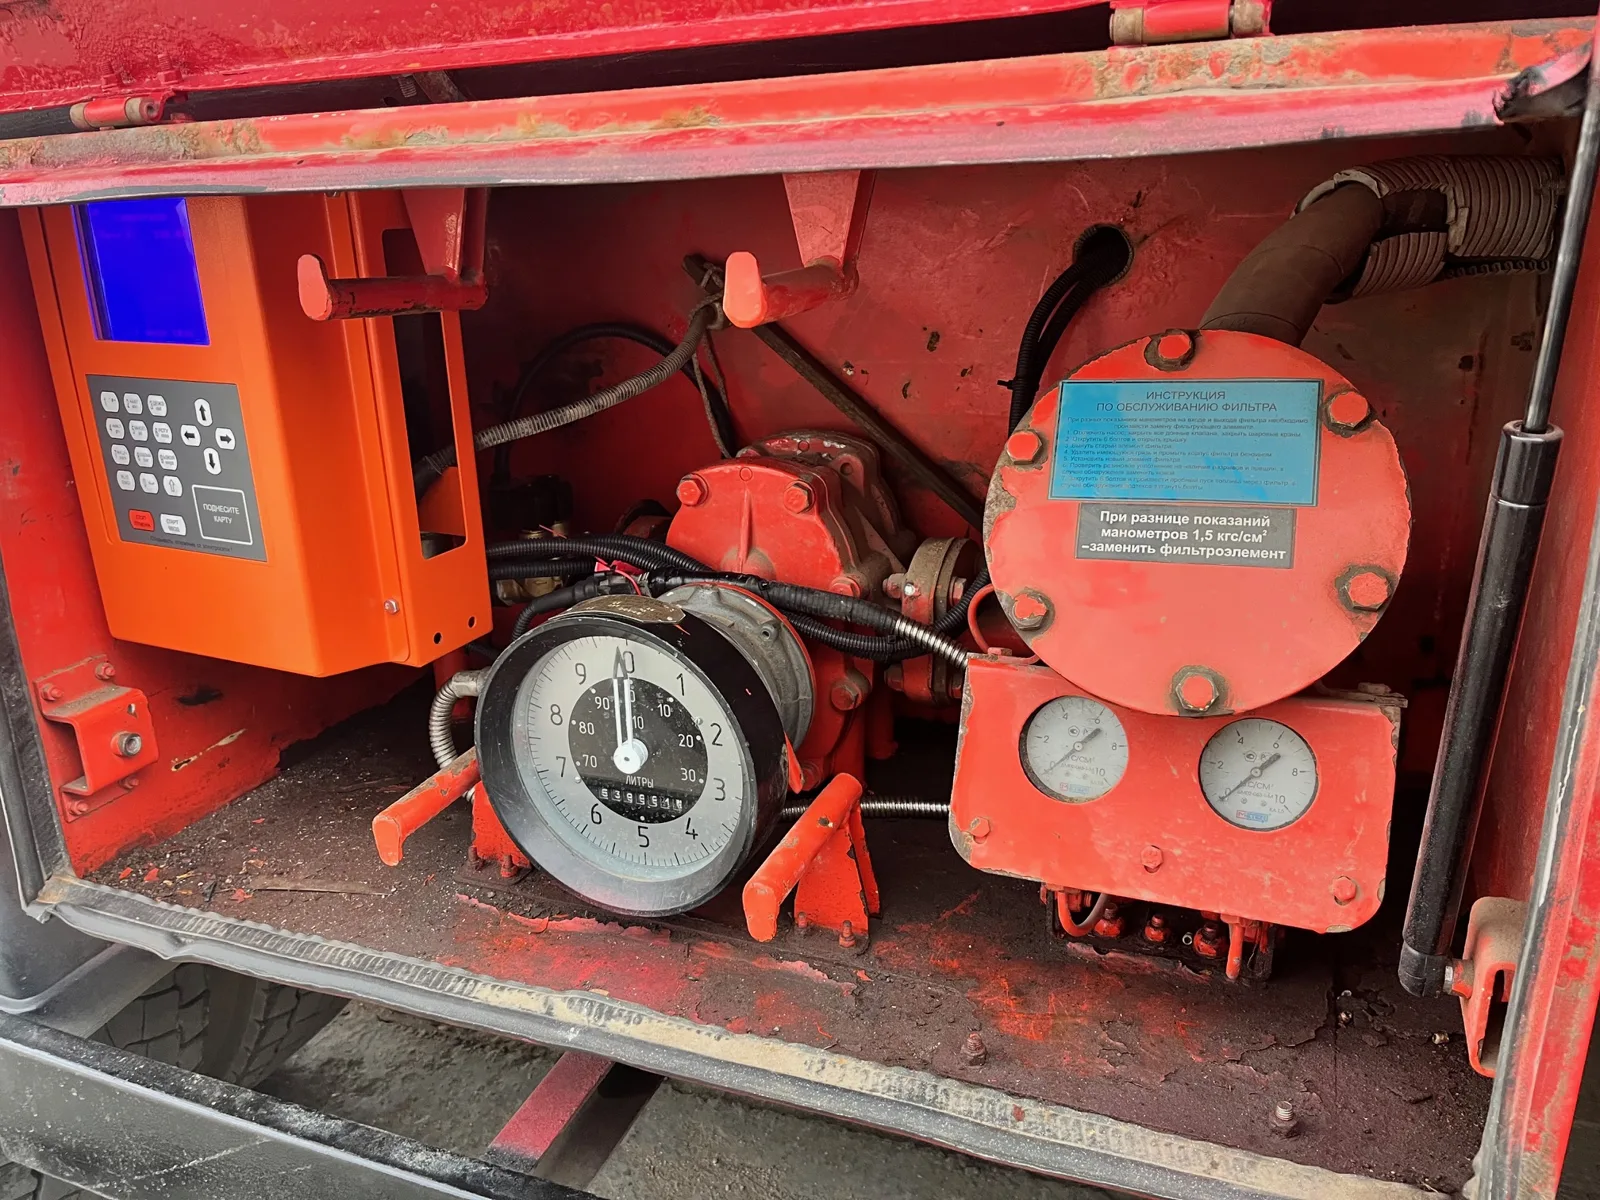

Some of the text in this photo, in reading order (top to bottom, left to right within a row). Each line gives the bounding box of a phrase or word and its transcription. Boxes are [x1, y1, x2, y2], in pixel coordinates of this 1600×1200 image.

[1146, 391, 1226, 401] ИНСТРУКЦИЯ
[1096, 402, 1277, 412] ПО ОБСЛУЖИВАНИЮ ФИЛЬТРА
[203, 503, 240, 515] ПОДНЕСИТЕ
[213, 515, 233, 524] КАРТУ
[1100, 511, 1270, 527] При разнице показаний
[1101, 529, 1188, 542] манометров
[1192, 530, 1213, 542] 1,5
[1160, 543, 1286, 560] фильтроэлемент
[622, 651, 635, 674] 0
[575, 662, 587, 685] 9
[676, 673, 685, 697] 1
[594, 697, 610, 710] 90
[550, 703, 563, 726] 8
[658, 704, 671, 718] 10
[579, 722, 595, 735] 80
[710, 722, 723, 746] 2
[678, 733, 694, 748] 20
[1043, 735, 1050, 743] 2
[1237, 736, 1244, 745] 4
[1112, 742, 1118, 751] 8
[555, 756, 567, 777] 7
[582, 754, 598, 768] 70
[1217, 761, 1224, 769] 2
[680, 767, 696, 782] 30
[1095, 767, 1106, 777] 10
[1291, 768, 1298, 777] 8
[626, 775, 654, 788] ЛИТРЫ
[713, 777, 726, 801] 3
[1275, 794, 1286, 804] 10
[590, 803, 602, 824] 6
[685, 817, 699, 839] 4
[637, 825, 650, 848] 5
